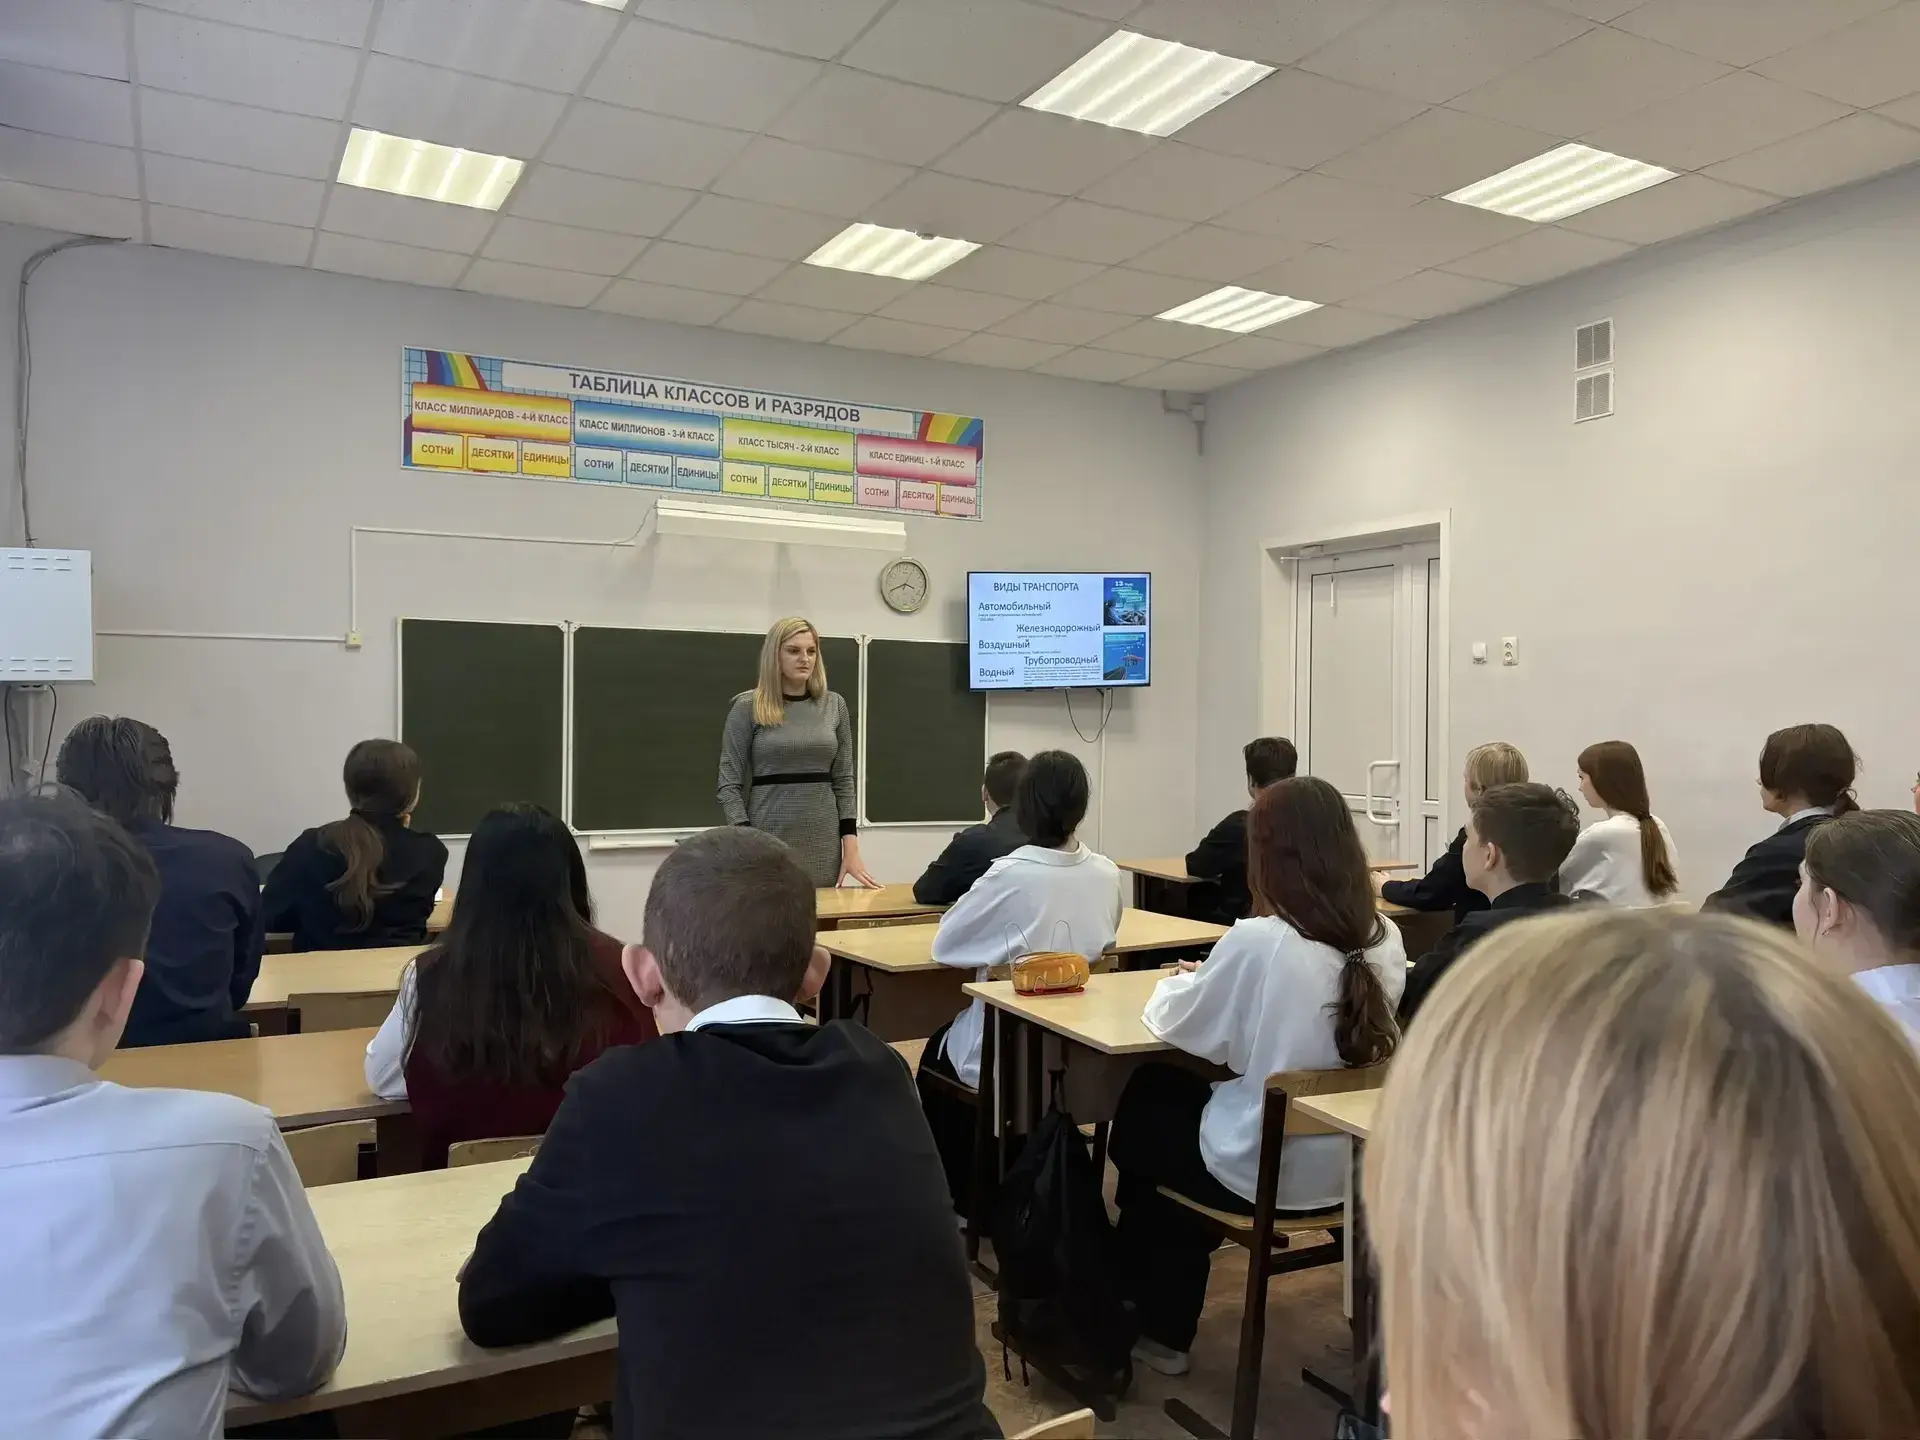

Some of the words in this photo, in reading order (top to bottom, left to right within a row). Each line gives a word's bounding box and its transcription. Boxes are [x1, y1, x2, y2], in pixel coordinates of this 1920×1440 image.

[569, 372, 659, 399] ТАБЛИЦА
[664, 385, 749, 409] КЛАССОВ
[755, 396, 766, 411] И
[772, 398, 860, 422] РАЗРЯДОВ
[414, 401, 447, 413] КЛАСС
[449, 404, 514, 420] МИЛЛИАРДОВ
[522, 411, 536, 422] 4-Й
[538, 414, 568, 425] КЛАСС
[579, 418, 609, 431] КЛАСС
[611, 422, 665, 437] МИЛЛИОНОВ
[672, 427, 686, 439] 3-Й
[687, 431, 715, 442] КЛАСС
[421, 444, 454, 455] СОТНИ
[738, 436, 765, 448] КЛАСС
[766, 439, 795, 451] ТЫСЯЧ
[800, 442, 813, 453] 2-Й
[814, 445, 839, 456] КЛАСС
[471, 447, 515, 460] ДЕСЯТКИ
[523, 452, 569, 466] ЕДИНИЦЫ
[584, 458, 614, 470] СОТНИ
[869, 451, 894, 461] КЛАСС
[895, 454, 924, 465] ЕДИНИЦ
[942, 459, 965, 469] КЛАСС
[630, 462, 669, 475] ДЕСЯТКИ
[677, 467, 719, 480] ЕДИНИЦЫ
[730, 474, 757, 484] СОТНИ
[771, 477, 808, 489] ДЕСЯТКИ
[814, 480, 852, 493] ЕДИНИЦЫ
[864, 487, 889, 497] СОТНИ
[902, 490, 935, 501] ДЕСЯТКИ
[941, 494, 975, 505] ЕДИНИЦЫ
[994, 582, 1021, 593] ВИДЫ
[1023, 582, 1079, 592] ТРАНСПОРТА
[978, 601, 1051, 611] Автомобильный
[1016, 623, 1101, 634] Железнодорожный
[978, 639, 1030, 650] Воздушный
[1024, 655, 1099, 667] Трубопроводный
[979, 666, 1015, 678] Водный
